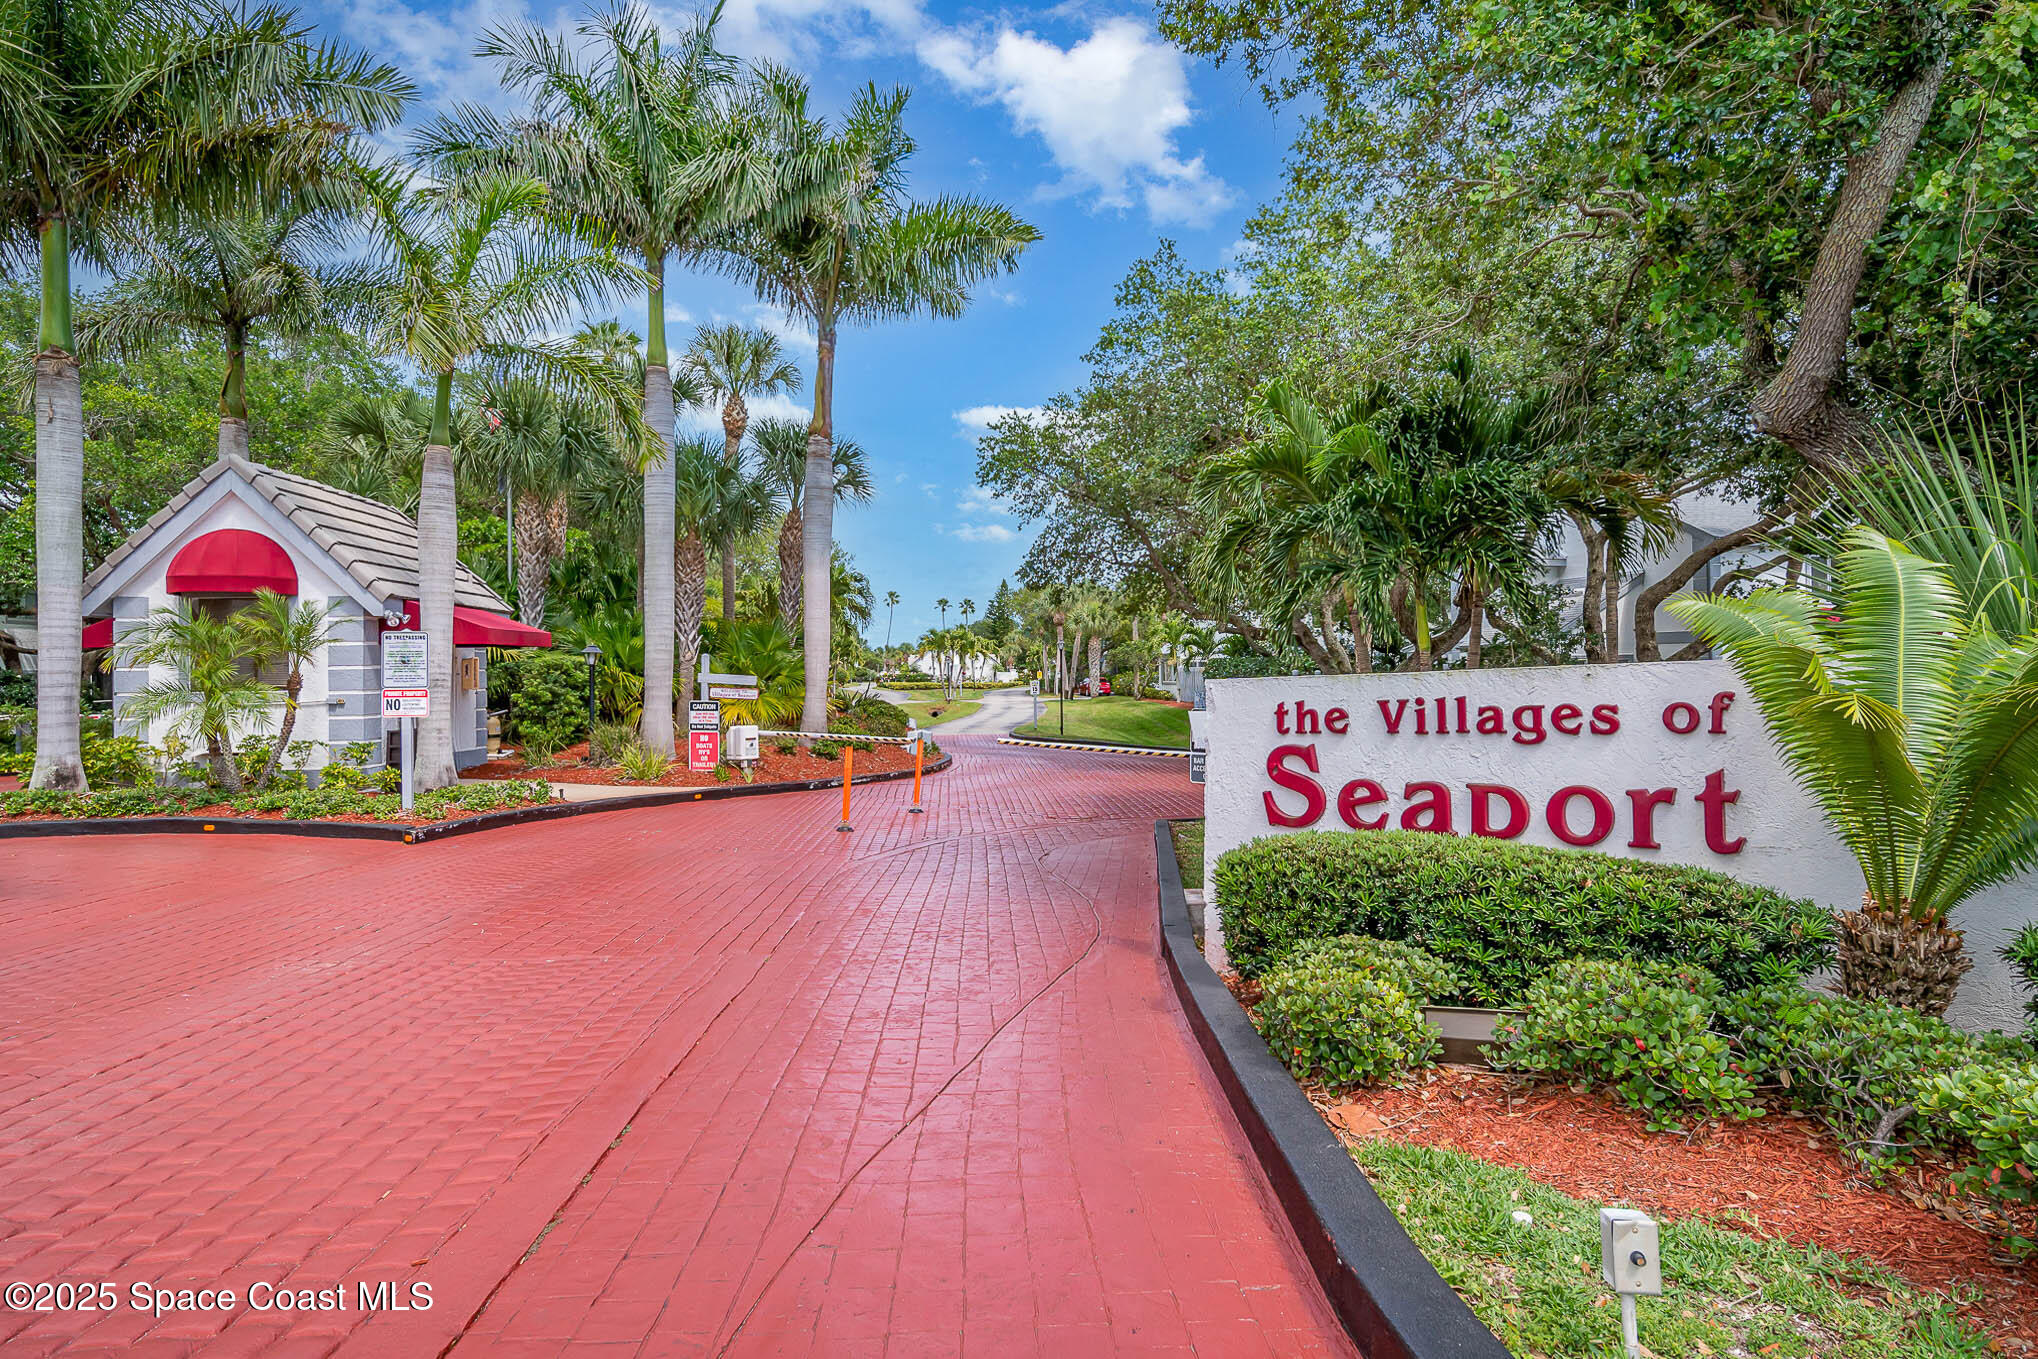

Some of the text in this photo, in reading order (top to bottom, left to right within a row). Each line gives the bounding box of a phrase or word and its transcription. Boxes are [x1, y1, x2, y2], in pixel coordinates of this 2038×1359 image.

[386, 698, 401, 711] NO
[1275, 691, 1736, 745] the Villages of
